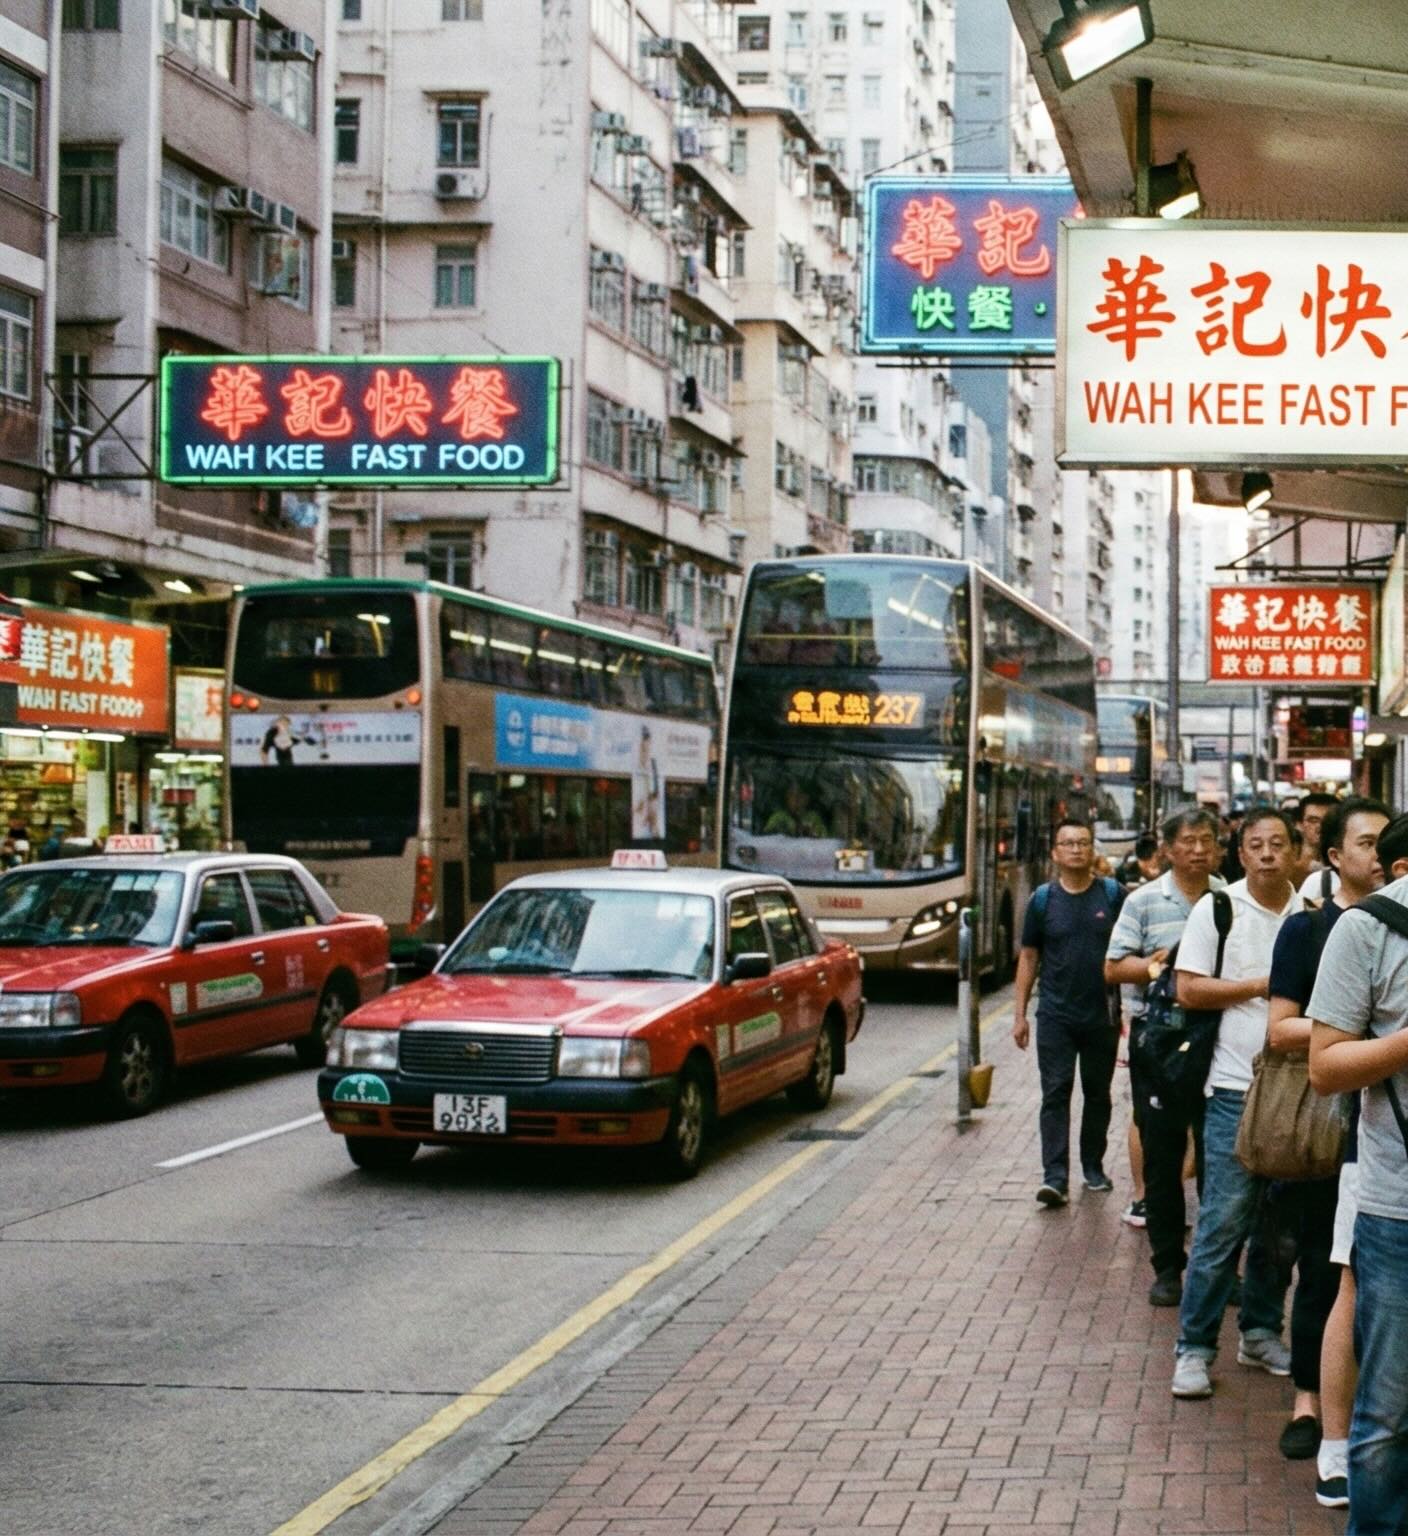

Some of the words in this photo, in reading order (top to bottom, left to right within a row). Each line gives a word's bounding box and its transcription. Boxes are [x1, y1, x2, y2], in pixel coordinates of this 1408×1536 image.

[891, 197, 1086, 278] 華記
[202, 365, 518, 441] 華記快餐
[1084, 381, 1173, 425] WAH
[1188, 382, 1265, 425] KEE
[1280, 384, 1375, 427] FAST
[185, 444, 255, 470] WAH
[266, 444, 324, 470] KEE
[351, 444, 426, 470] FAST
[439, 444, 525, 470] FOOD
[1215, 593, 1368, 634] 華記快餐
[20, 622, 136, 688] 華記快餐
[1214, 635, 1249, 650] WAH
[1252, 636, 1282, 650] KEE
[1284, 636, 1321, 650] FAST
[1324, 637, 1366, 650] FOOD
[18, 684, 56, 710] WAH
[60, 689, 97, 714] FAST
[874, 694, 921, 725] 237
